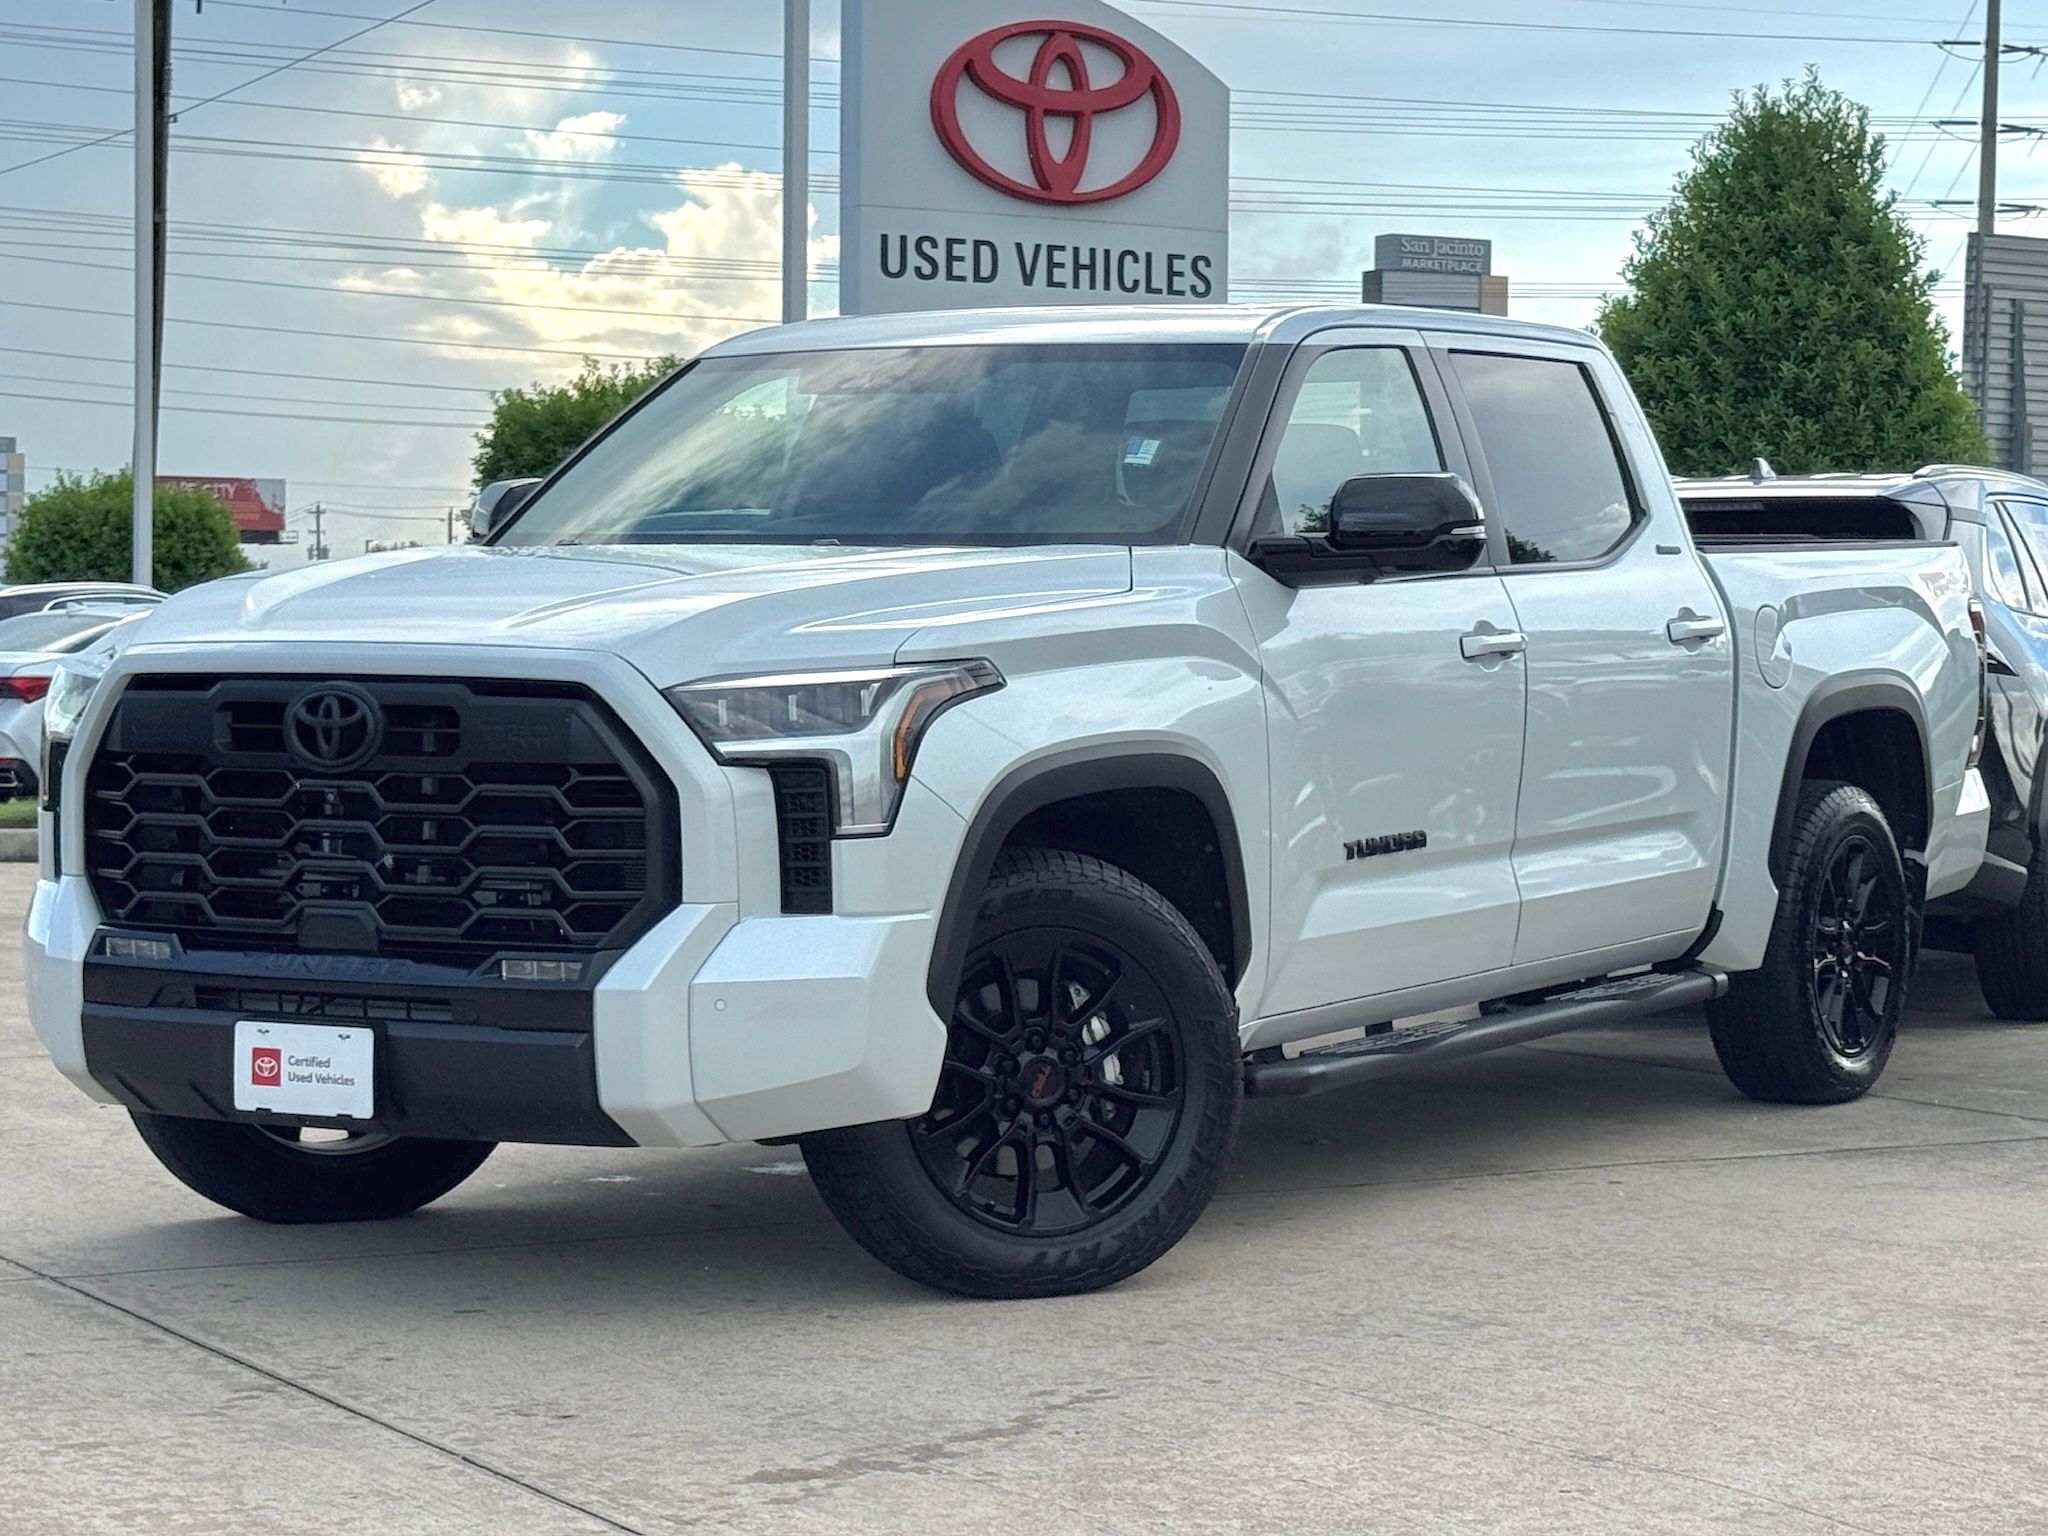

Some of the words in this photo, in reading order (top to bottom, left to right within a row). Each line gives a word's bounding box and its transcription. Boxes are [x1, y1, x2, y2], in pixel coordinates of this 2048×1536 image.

[1401, 237, 1429, 252] San
[1431, 239, 1484, 257] Jacinto
[880, 234, 998, 284] USED
[1014, 243, 1213, 298] VEHICLES
[1401, 258, 1482, 273] MARKETPLACE
[1344, 830, 1427, 860] TUNDRA
[288, 1055, 331, 1068] Certified
[288, 1071, 313, 1084] Used
[315, 1073, 355, 1087] Vehicles
